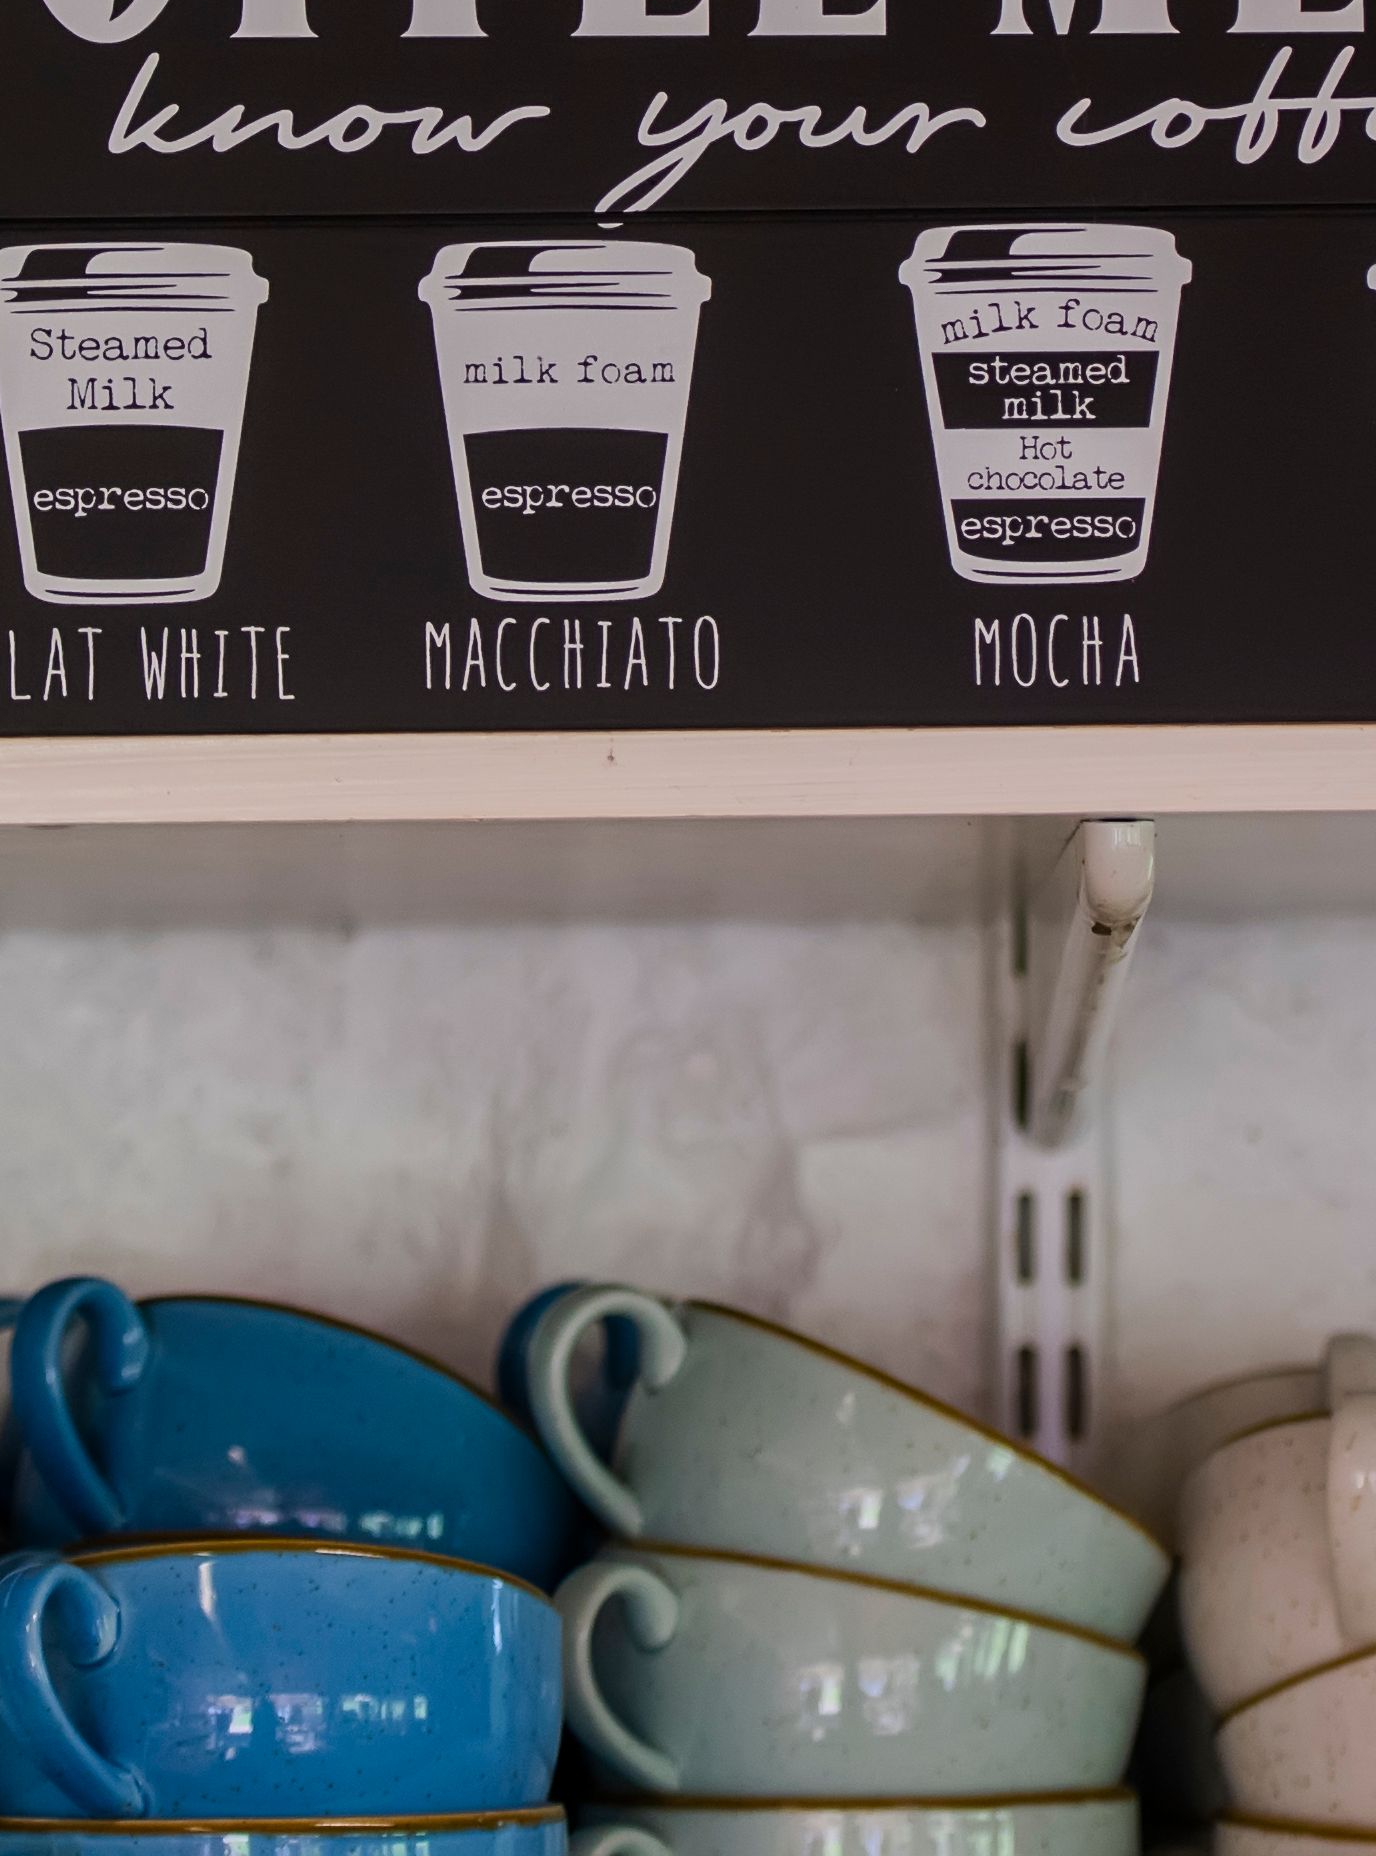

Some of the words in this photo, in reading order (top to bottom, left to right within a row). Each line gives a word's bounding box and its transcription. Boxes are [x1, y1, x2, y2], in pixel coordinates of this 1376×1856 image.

[108, 52, 551, 154] know
[594, 91, 986, 229] your
[940, 301, 1040, 346] milk
[1056, 299, 1160, 344] foam
[29, 326, 213, 361] Steamed
[463, 355, 559, 384] milk
[576, 354, 676, 384] foam
[967, 355, 1131, 386] steamed
[65, 377, 175, 412] Milk
[1001, 390, 1097, 422] milk
[1019, 435, 1073, 462] Hot
[967, 466, 1126, 492] chocolate
[33, 483, 209, 517] espresso
[481, 481, 658, 515] espresso
[960, 512, 1137, 545] espresso
[141, 625, 297, 701] WHITE
[424, 615, 721, 692] MACCHIATO
[974, 613, 1140, 690] MOCHA
